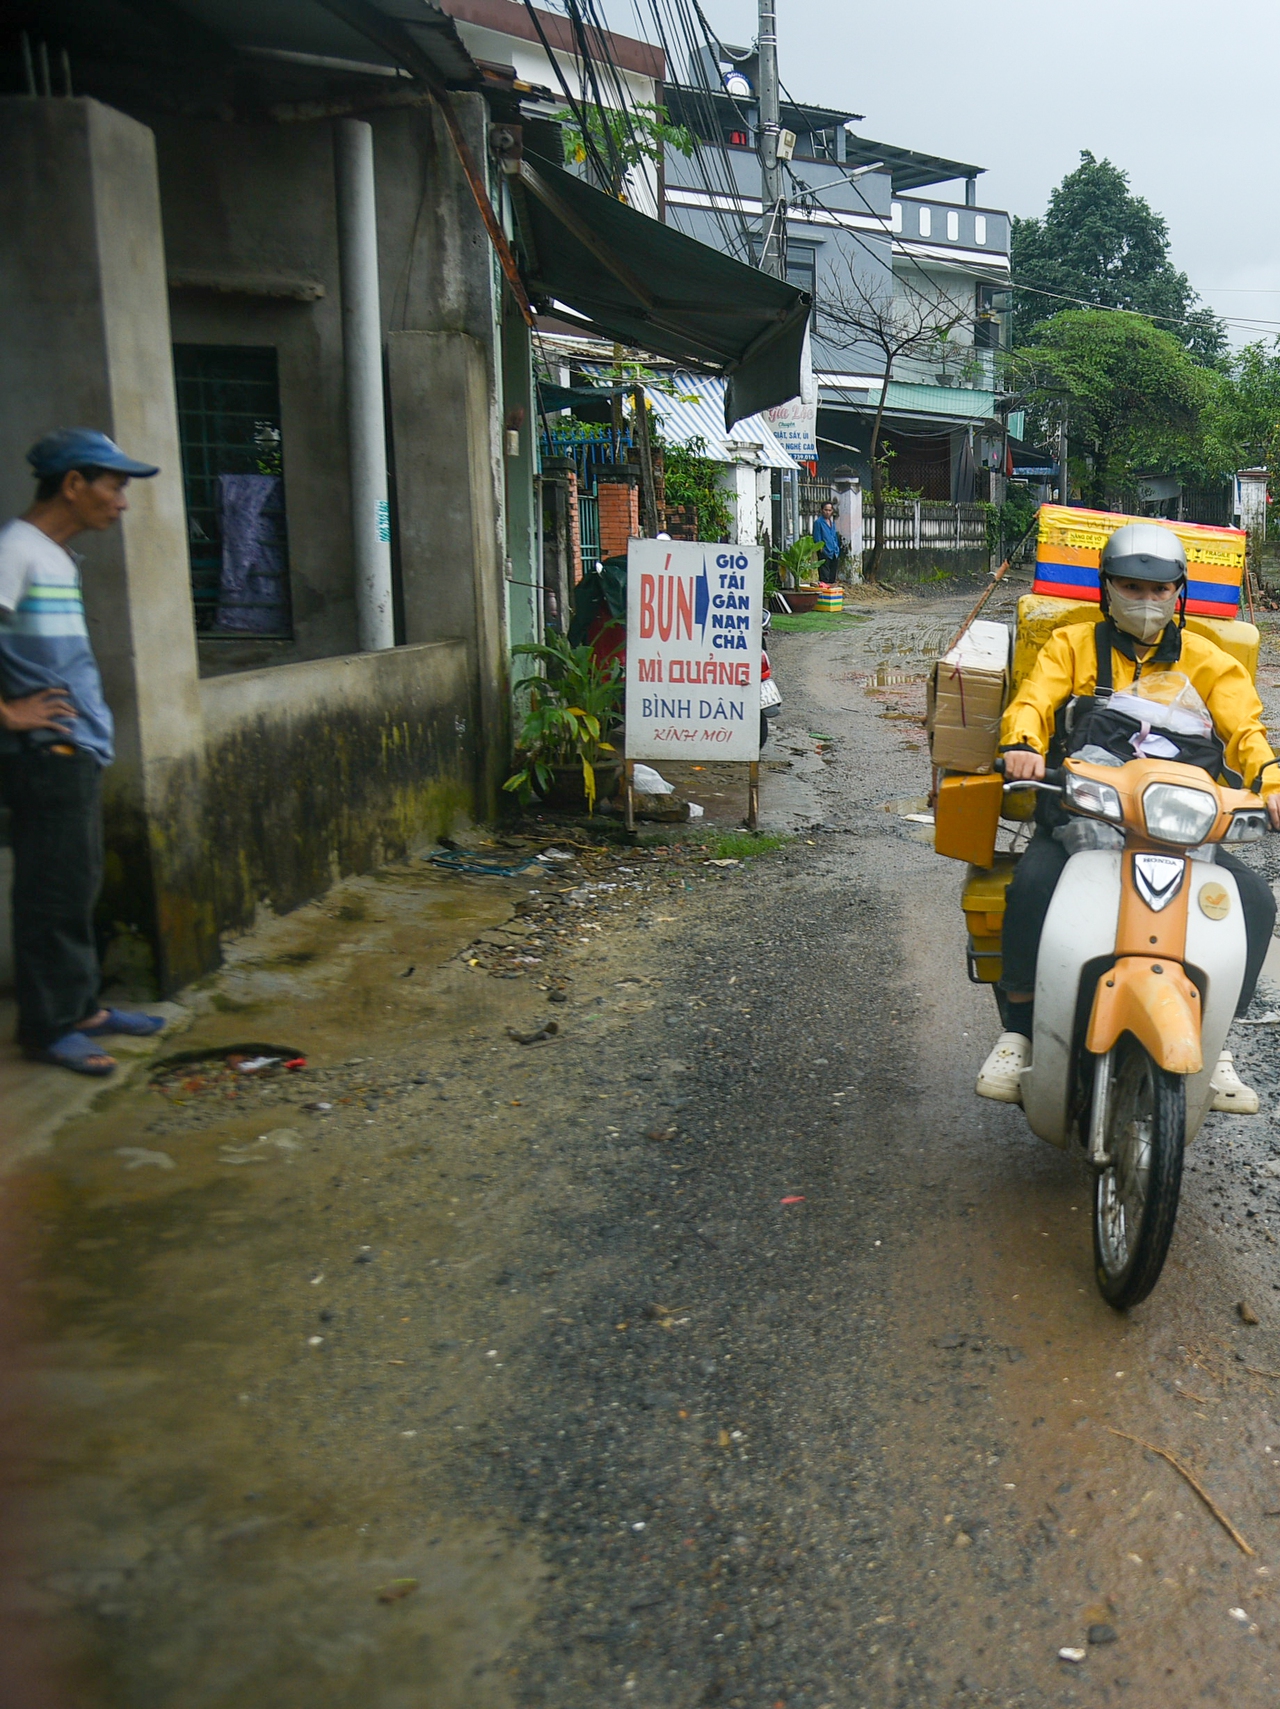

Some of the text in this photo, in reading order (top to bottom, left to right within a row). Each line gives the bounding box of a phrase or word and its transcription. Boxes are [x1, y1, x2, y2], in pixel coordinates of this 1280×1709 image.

[715, 551, 749, 570] GIÒ
[719, 571, 745, 590] TÁI
[640, 553, 694, 642] BÚN
[712, 591, 750, 610] GÂN
[712, 614, 750, 633] NẠM
[712, 630, 748, 650] CHẢ
[638, 651, 750, 687] MÌ QUẢNG
[642, 693, 744, 720] BÌNH DÂN
[653, 725, 698, 742] KÍNH
[1143, 857, 1177, 866] HONDA
